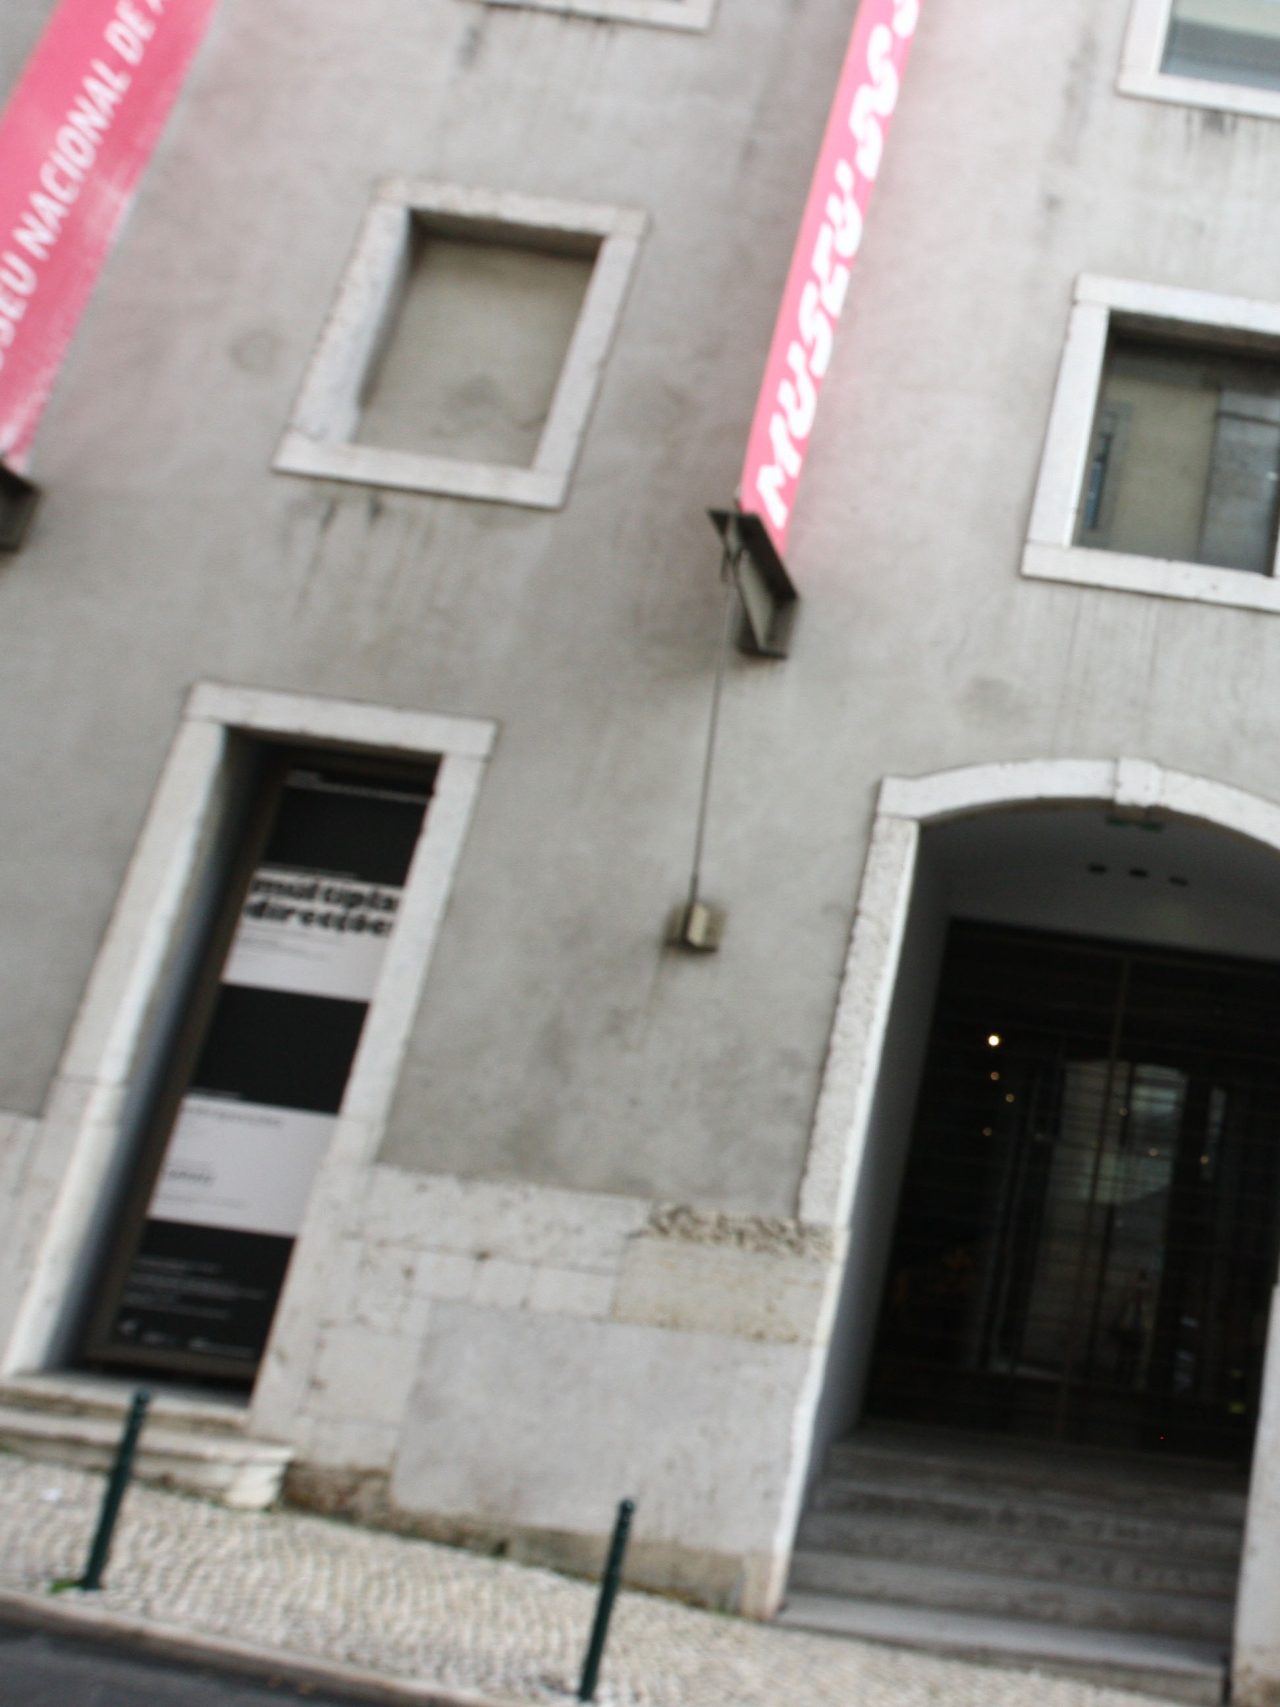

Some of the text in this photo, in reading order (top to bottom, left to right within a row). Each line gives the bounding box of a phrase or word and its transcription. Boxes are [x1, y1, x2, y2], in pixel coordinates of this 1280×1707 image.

[10, 56, 133, 262] NACIONAL
[103, 0, 157, 67] DE
[755, 157, 864, 530] MUSEU
